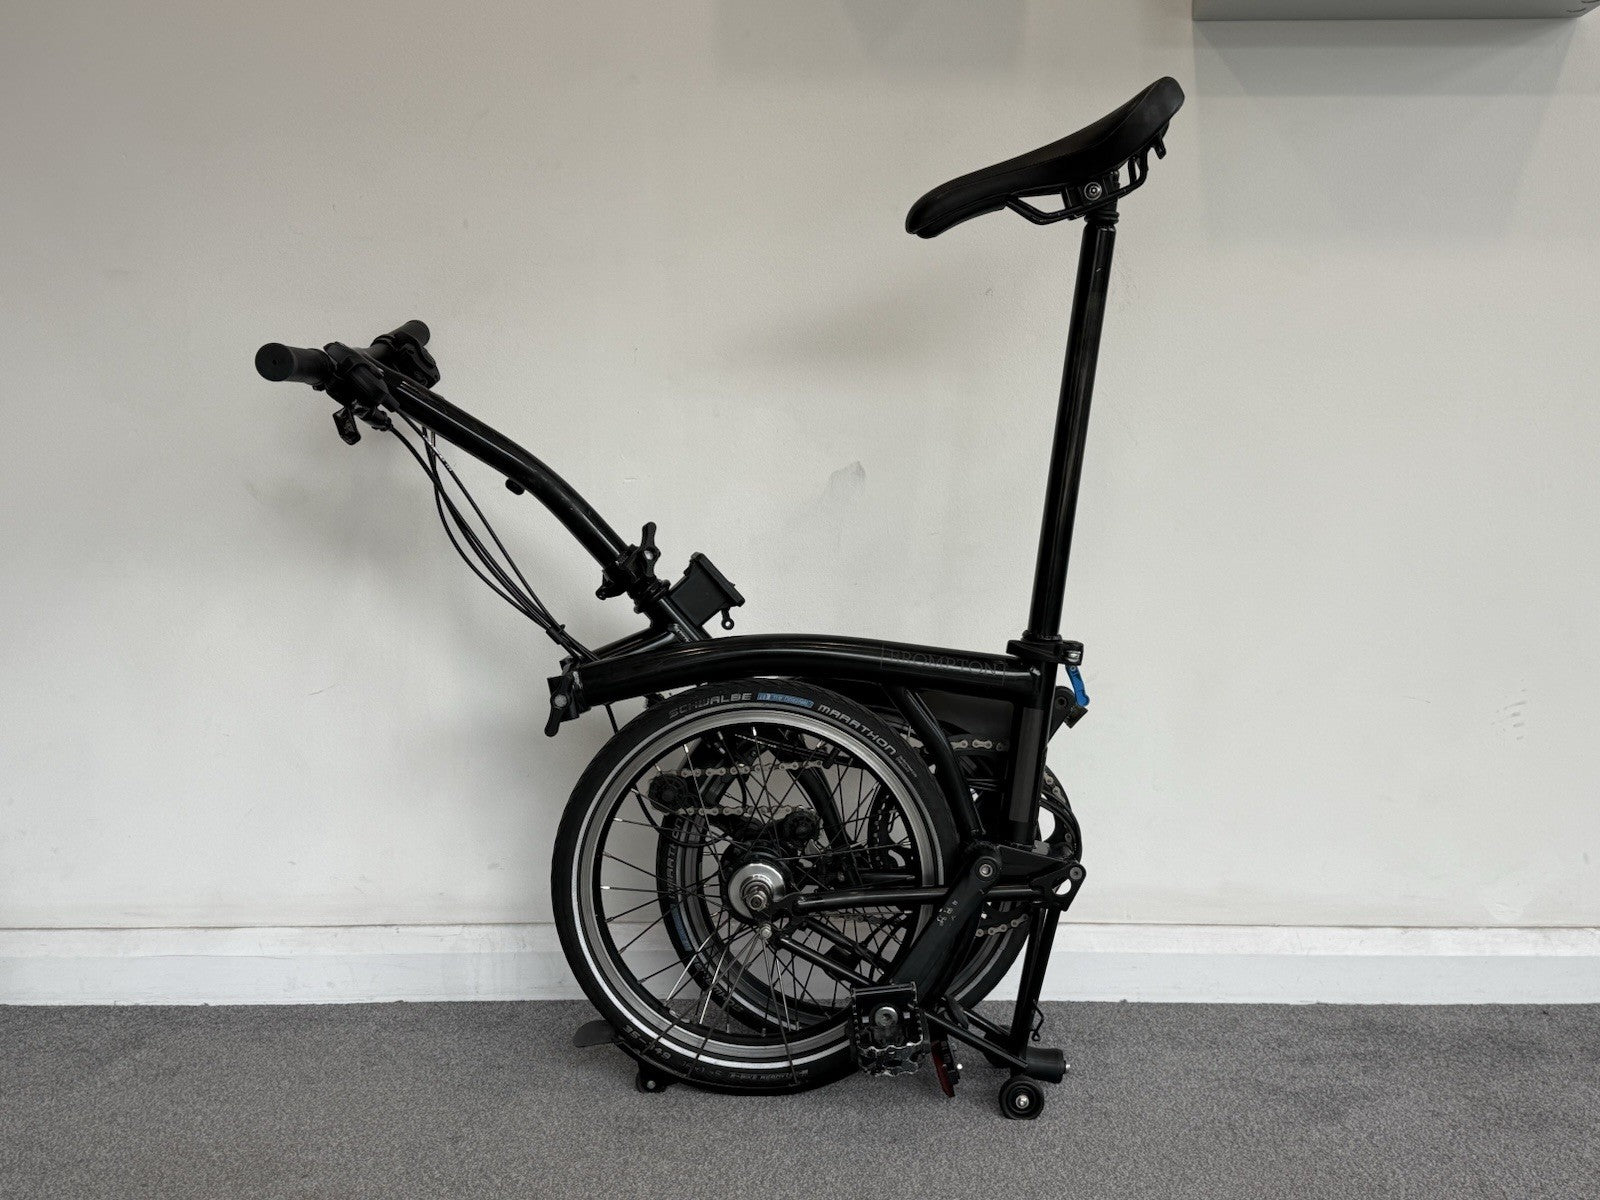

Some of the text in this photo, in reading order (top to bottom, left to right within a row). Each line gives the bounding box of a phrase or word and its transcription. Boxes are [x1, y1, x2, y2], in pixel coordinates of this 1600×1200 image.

[889, 648, 997, 677] BROMPTON
[668, 692, 752, 719] SCHWALBE
[817, 704, 897, 756] MARATHON
